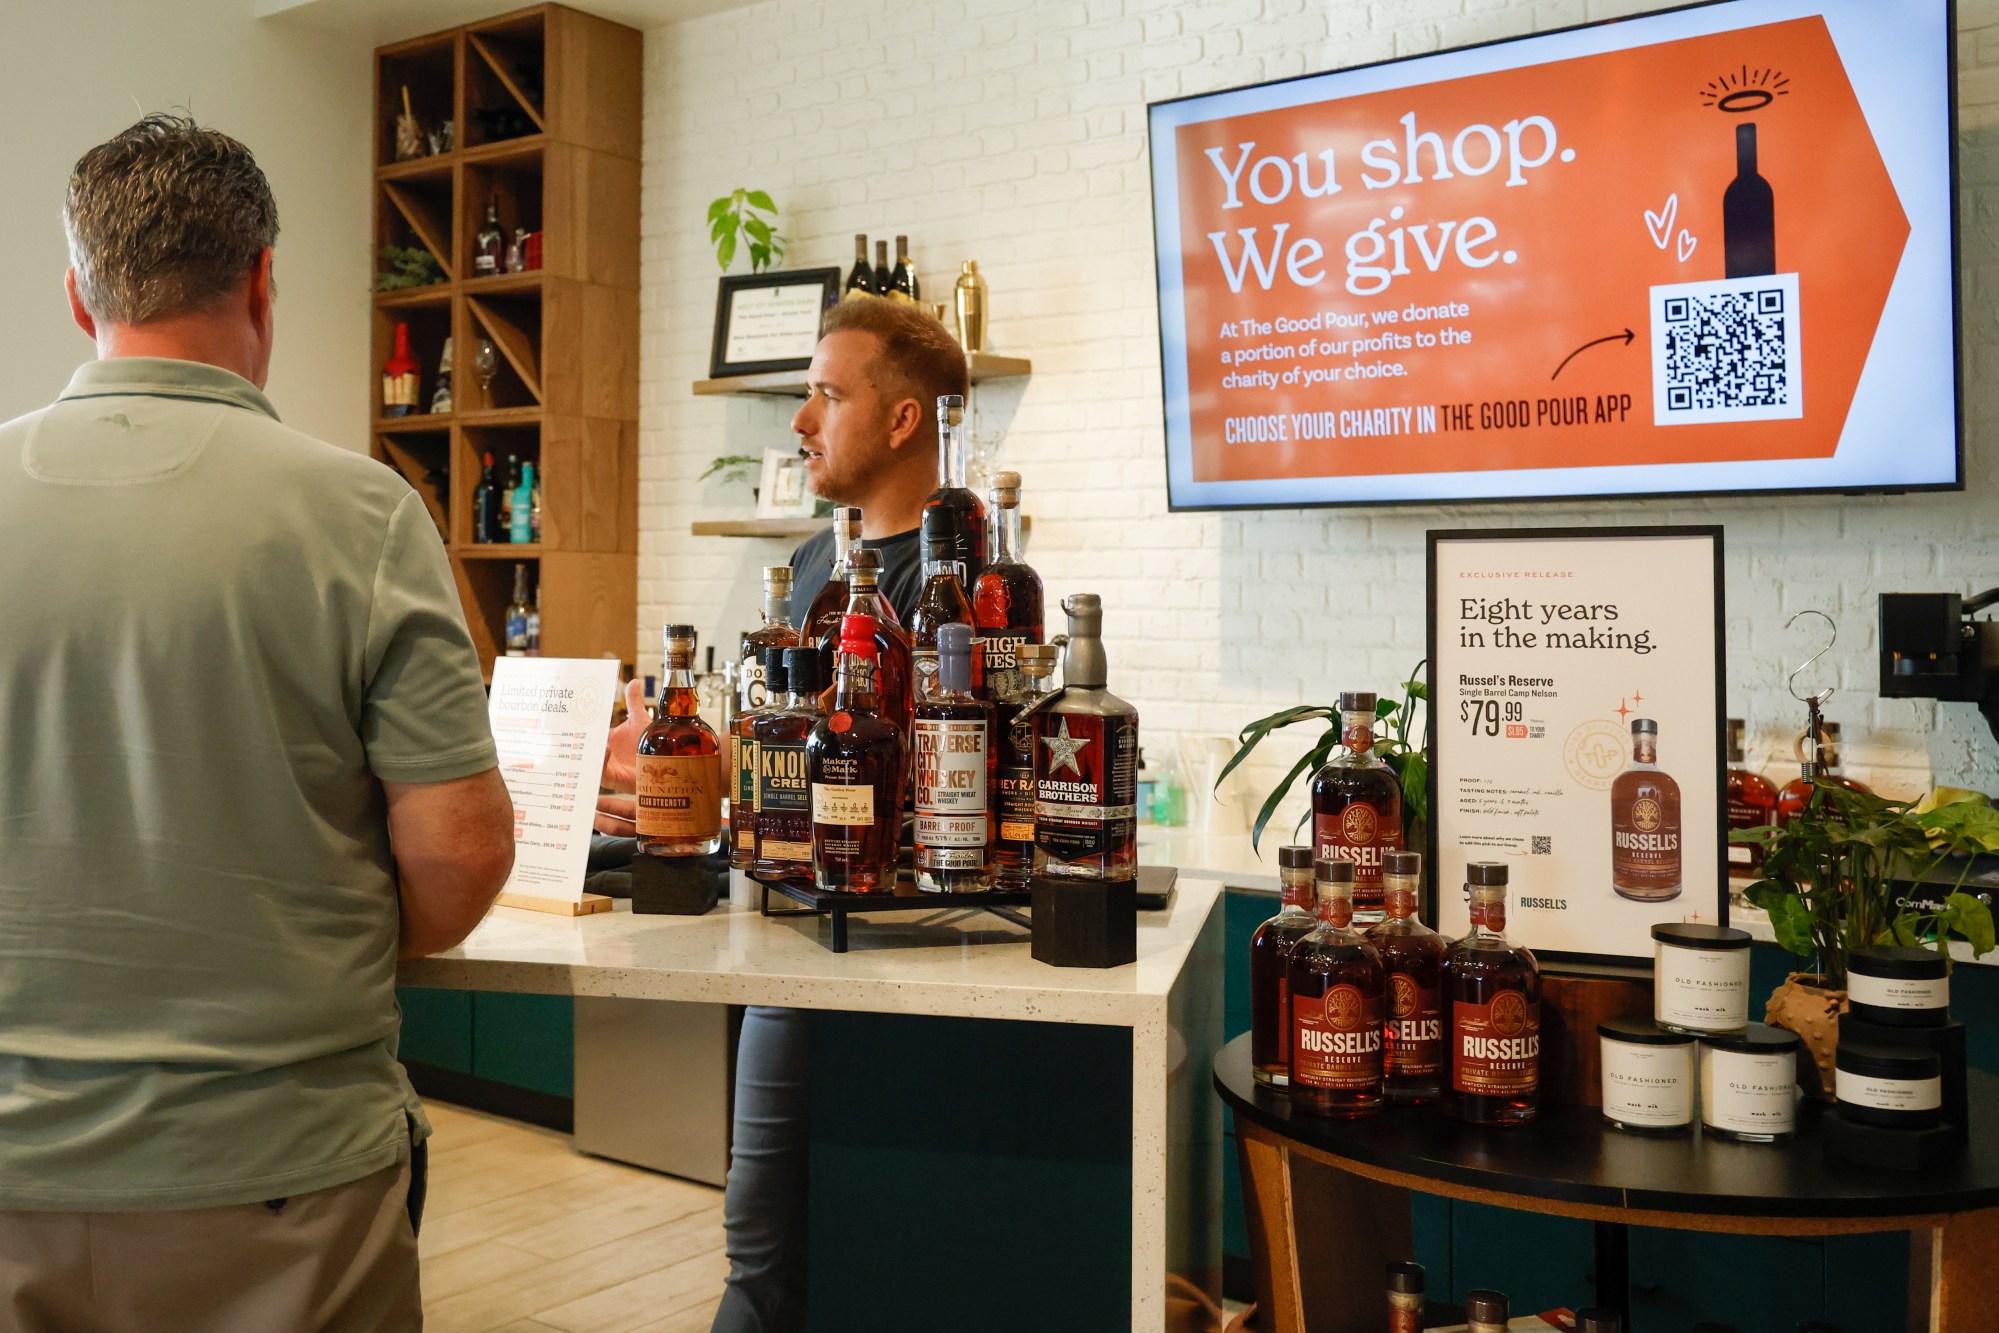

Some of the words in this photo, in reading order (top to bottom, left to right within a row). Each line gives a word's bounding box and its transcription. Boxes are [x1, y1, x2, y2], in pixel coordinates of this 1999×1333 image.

[1204, 141, 1342, 209] You
[1361, 111, 1576, 190] shop.
[1207, 222, 1326, 293] We
[1344, 206, 1518, 295] give.
[1220, 322, 1238, 338] At
[1241, 319, 1271, 336] The
[1275, 314, 1321, 333] Good
[1325, 312, 1369, 329] Pour,
[1371, 309, 1398, 324] we
[1402, 301, 1470, 321] donate
[1221, 351, 1231, 363] a
[1235, 343, 1295, 367] portion
[1299, 339, 1317, 357] of
[1320, 341, 1349, 356] our
[1352, 333, 1412, 357] profits
[1416, 331, 1436, 347] to
[1440, 327, 1472, 344] the
[1222, 371, 1279, 390] charity
[1282, 367, 1300, 385] of
[1303, 368, 1341, 387] your
[1344, 361, 1408, 380] choice.
[1225, 412, 1287, 444] CHOOSE
[1291, 412, 1335, 440] YOUR
[1340, 407, 1412, 438] CHARITY
[1417, 405, 1436, 433] IN
[1441, 403, 1474, 432] THE
[1481, 401, 1530, 428] GOOD
[1537, 397, 1589, 426] POUR
[1595, 394, 1631, 423] APP
[1460, 598, 1533, 624] Eight
[1541, 603, 1618, 625] years
[984, 636, 1026, 653] HIGH
[1460, 626, 1485, 648] in
[1493, 626, 1537, 648] the
[1546, 626, 1657, 655] making.
[985, 654, 1016, 669] WES
[746, 669, 766, 678] DO
[1460, 675, 1505, 685] Russel's
[1509, 675, 1553, 686] Reserve
[501, 684, 537, 696] Limited
[539, 686, 574, 700] private
[1460, 688, 1482, 697] Single
[1509, 689, 1529, 698] Camp
[498, 698, 538, 711] bourbon
[541, 701, 569, 713] deals.
[918, 734, 981, 753] TRAVERSE
[918, 752, 943, 769] CITY
[770, 778, 806, 788] CREE
[918, 770, 975, 788] WHISKEY
[1038, 780, 1097, 793] GARRISON
[638, 785, 704, 794] MUNITION
[918, 787, 933, 805] CO.
[1039, 790, 1097, 803] BROTHERS
[920, 821, 945, 831] BARREL
[950, 822, 975, 831] PROOF
[1616, 831, 1677, 850] RUSSELL'S
[1322, 844, 1395, 866] RUSSEL'
[1520, 897, 1567, 910] RUSSELL'S
[1385, 1020, 1442, 1041] SELL'S
[1301, 1028, 1380, 1054] RUSSELL'S
[1463, 1035, 1539, 1060] RUSSELL'S
[1461, 1067, 1489, 1076] PRIVATE
[1729, 1082, 1747, 1090] OLD
